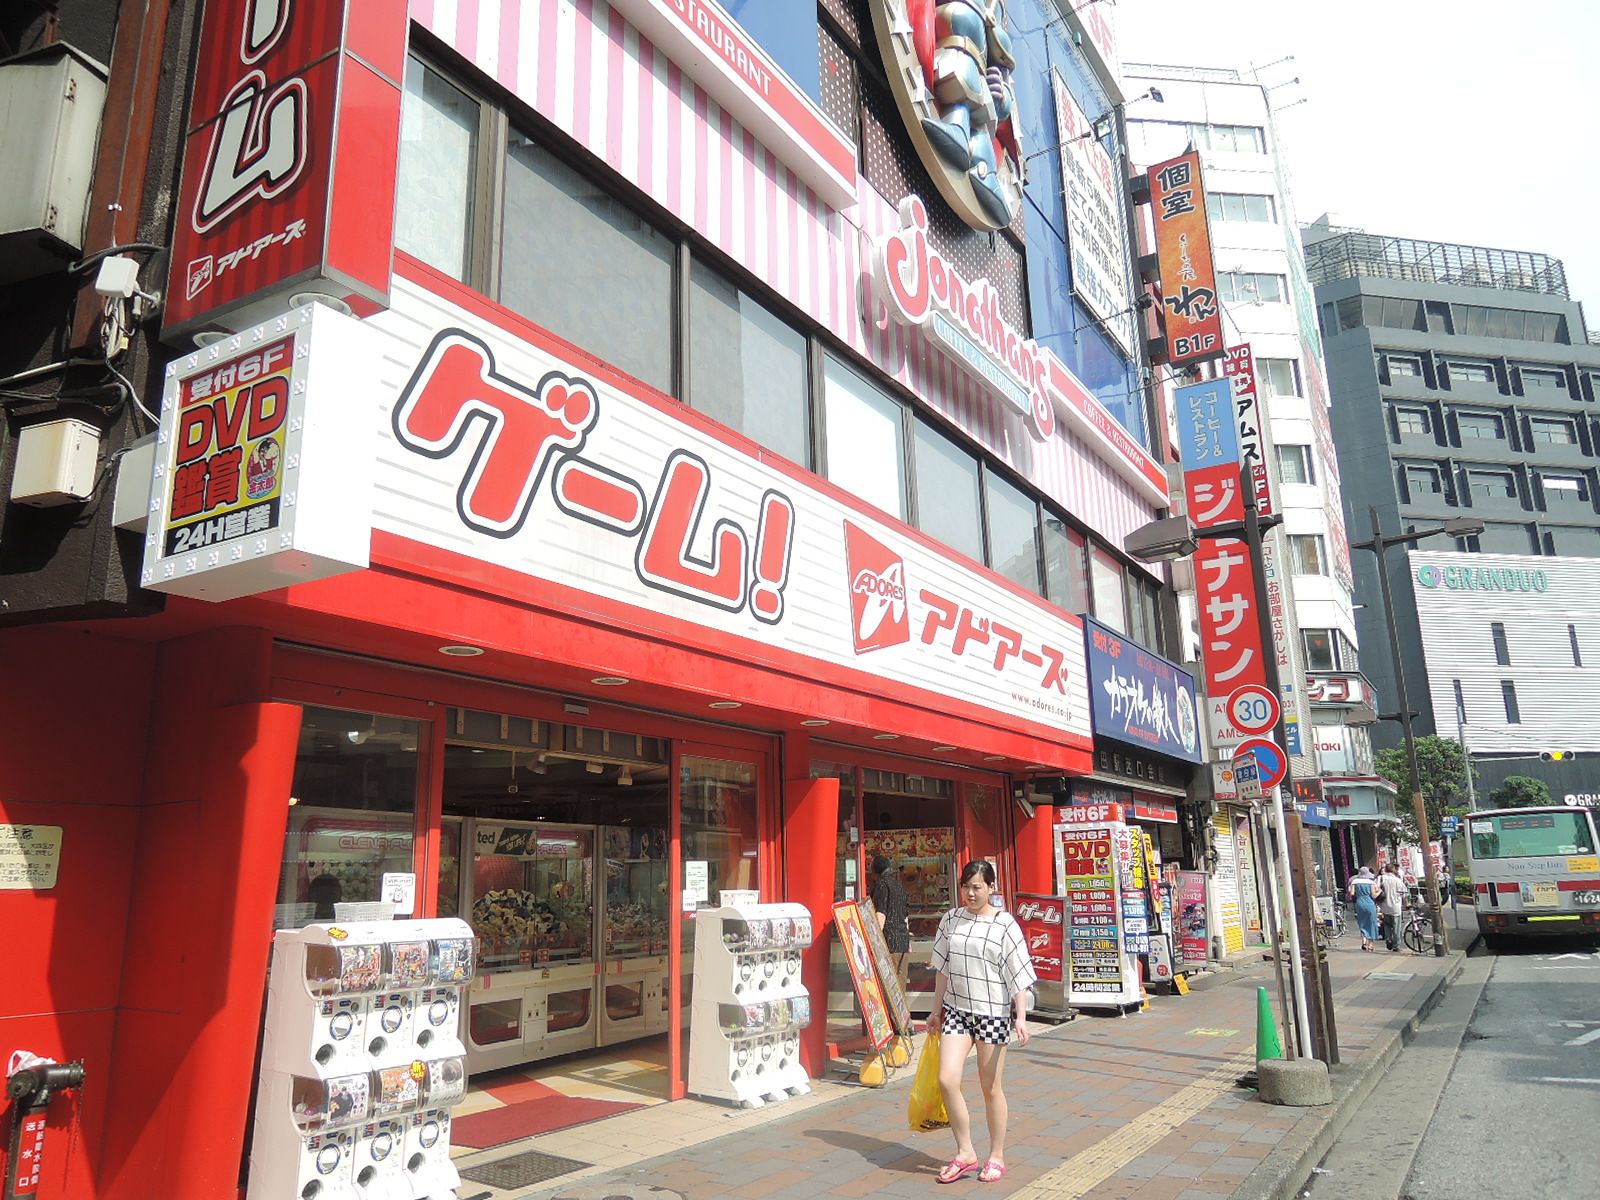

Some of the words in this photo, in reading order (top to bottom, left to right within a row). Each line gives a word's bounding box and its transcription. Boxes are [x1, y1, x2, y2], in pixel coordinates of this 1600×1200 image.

[1156, 161, 1196, 221] 個室
[216, 218, 307, 277] アドアーズ
[1174, 334, 1216, 358] B1F
[189, 344, 286, 403] 受付6F
[176, 375, 289, 465] DVD
[1188, 395, 1209, 461] レストラン
[1236, 399, 1260, 461] アムス
[172, 503, 272, 554] 24H営業
[854, 572, 904, 601] ADORES
[1444, 566, 1548, 592] GRANDUO
[919, 588, 1069, 695] アドアーズ
[1239, 699, 1268, 721] 30
[1060, 805, 1109, 822] 受付6F
[476, 831, 496, 845] ted
[1064, 830, 1108, 841] 受付6F
[1064, 841, 1111, 859] DVD
[1017, 902, 1062, 925] ゲーム
